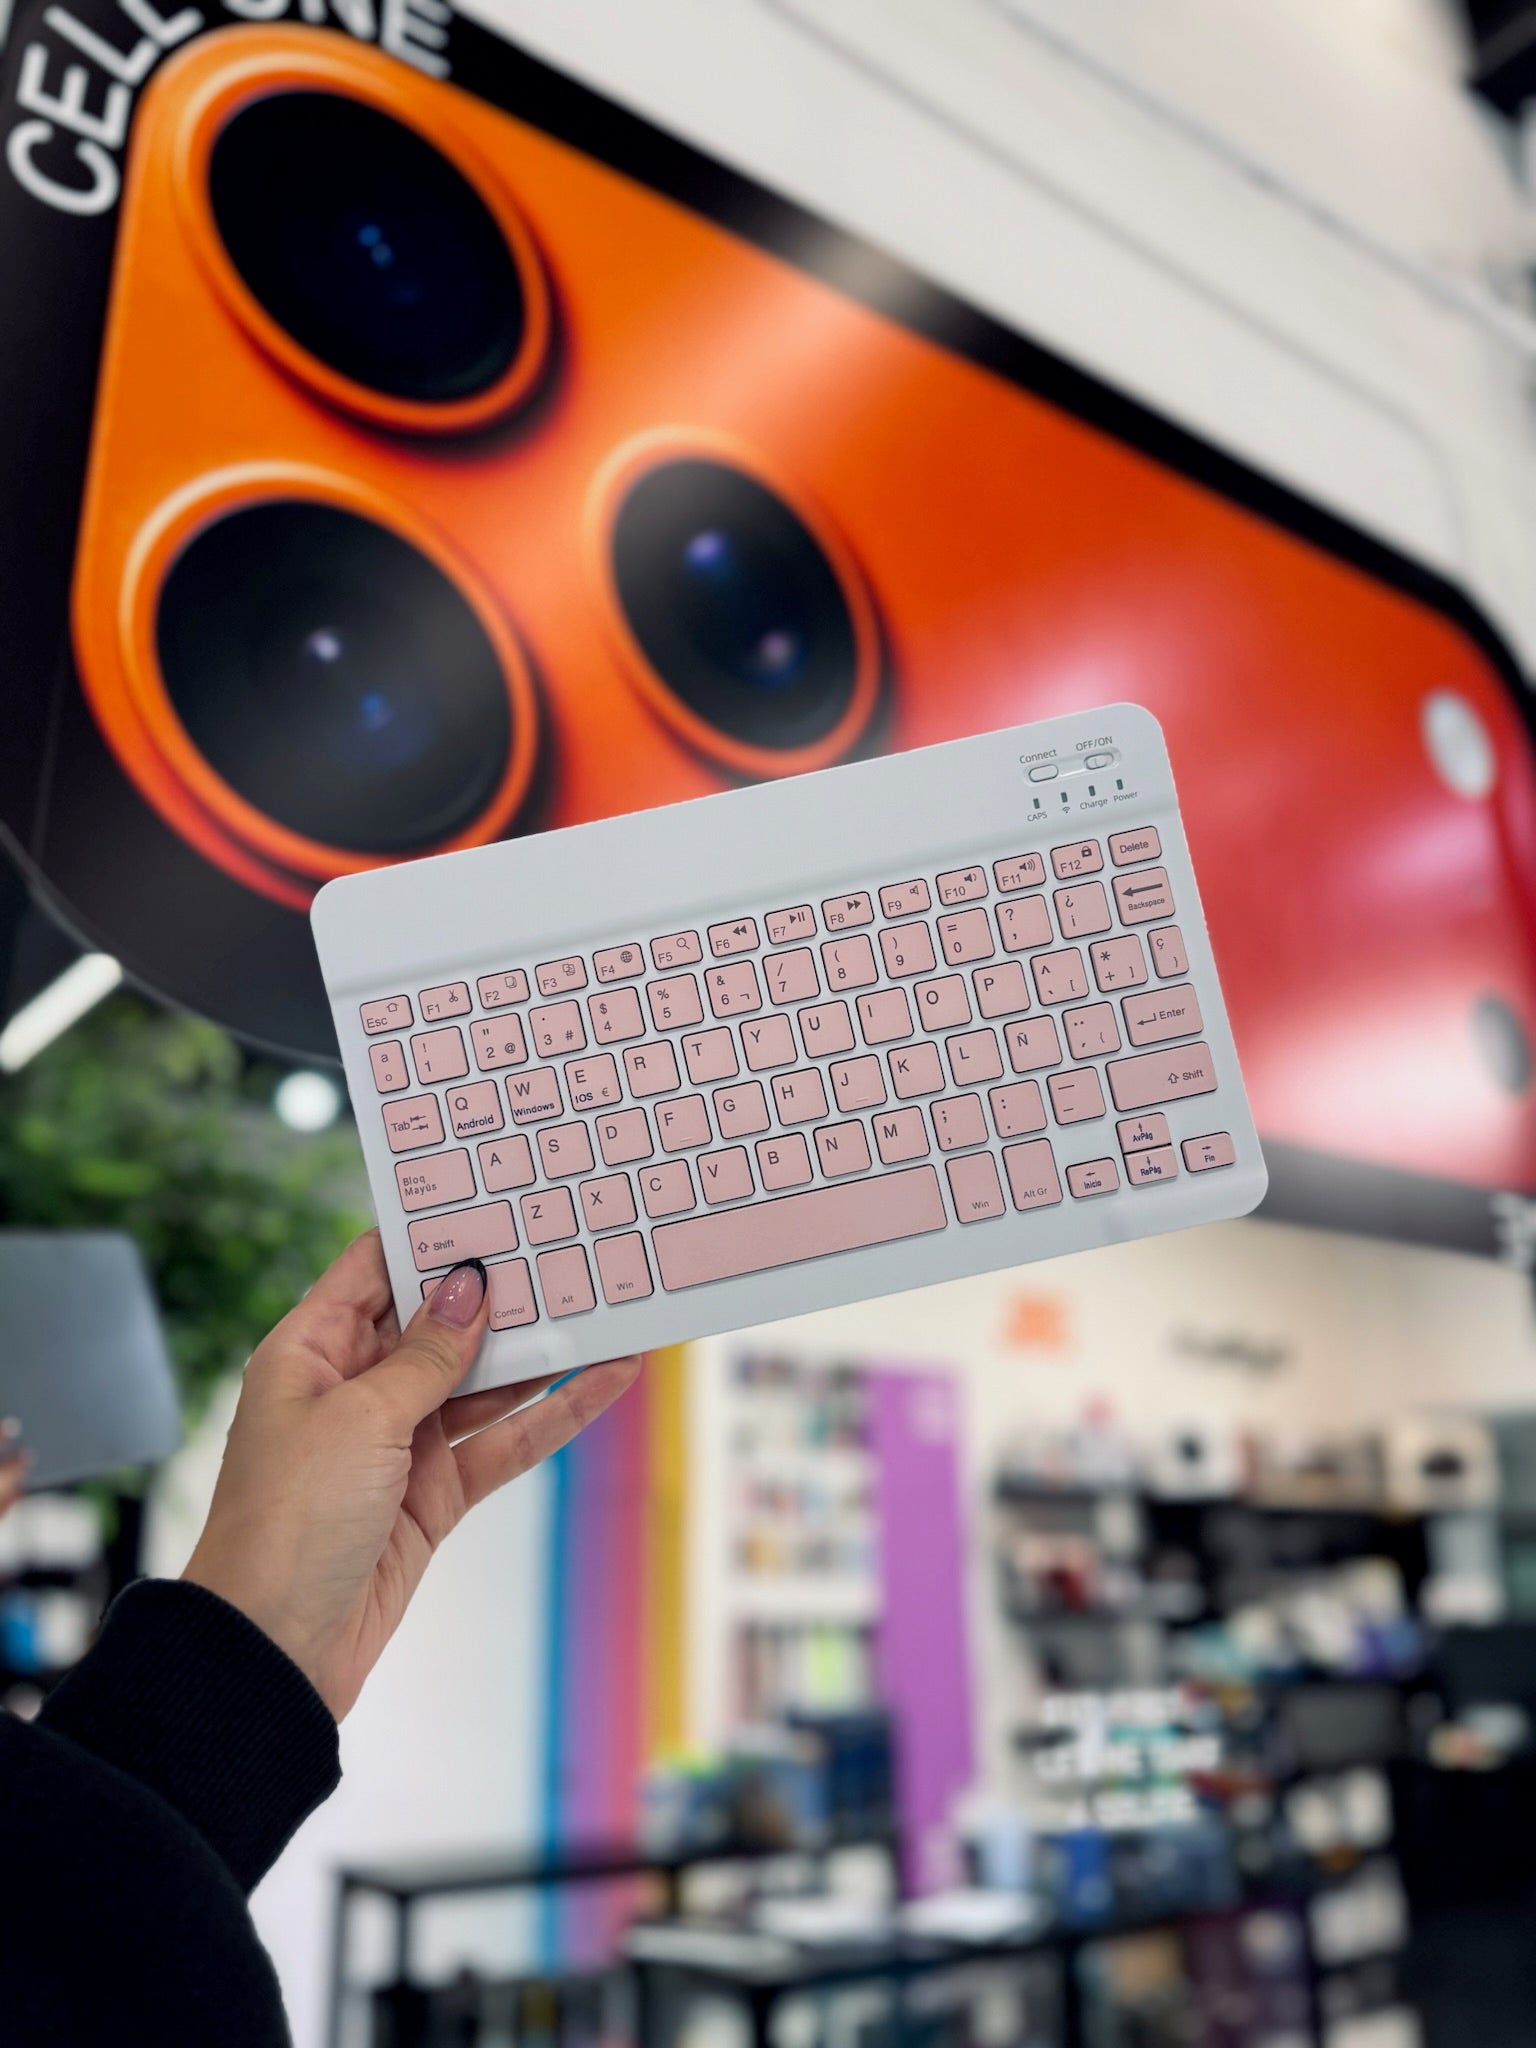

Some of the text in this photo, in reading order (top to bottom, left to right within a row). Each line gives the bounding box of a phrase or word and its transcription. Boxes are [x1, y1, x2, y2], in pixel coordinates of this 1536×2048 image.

[1076, 736, 1112, 751] OFF/ON
[1019, 749, 1057, 764] Connect
[1114, 791, 1138, 802] Power
[1080, 798, 1108, 810] Charge
[1027, 812, 1048, 822] CAPS
[1120, 840, 1149, 854] Delete
[1060, 860, 1082, 872] F12
[1002, 874, 1021, 886] F11
[944, 886, 965, 899] F10
[887, 900, 902, 912] F9
[1128, 898, 1165, 911] Backspace
[830, 913, 845, 925] F8
[1005, 908, 1014, 921] ?
[773, 926, 786, 937] F7
[715, 939, 730, 950] F6
[658, 952, 672, 963] F5
[895, 954, 904, 966] 9
[601, 965, 615, 976] F4
[837, 968, 846, 979] 8
[542, 978, 557, 989] F3
[716, 975, 725, 986] &
[778, 981, 787, 992] 7
[984, 977, 994, 992] P
[485, 991, 500, 1002] F2
[657, 988, 669, 1000] %
[721, 994, 730, 1005] 6
[926, 991, 939, 1005] O
[427, 1004, 441, 1015] F1
[600, 1003, 607, 1015] $
[663, 1007, 671, 1018] 5
[868, 1004, 873, 1018] I
[1159, 1008, 1186, 1020] Enter
[367, 1016, 388, 1029] Esc
[604, 1021, 612, 1032] 4
[808, 1016, 820, 1031] U
[544, 1030, 574, 1045] 3 #
[750, 1029, 761, 1043] Y
[1017, 1032, 1028, 1047] Ñ
[487, 1042, 516, 1058] 2 @
[692, 1043, 702, 1056] T
[959, 1047, 969, 1060] L
[424, 1060, 432, 1072] 1
[634, 1056, 646, 1070] R
[897, 1059, 910, 1073] K
[575, 1069, 587, 1083] E
[840, 1073, 849, 1086] J
[1182, 1069, 1204, 1081] Shift
[514, 1082, 530, 1097] W
[781, 1085, 794, 1100] H
[455, 1097, 469, 1111] Q
[514, 1102, 555, 1117] Windows
[723, 1099, 736, 1112] G
[456, 1115, 494, 1132] Android
[664, 1112, 674, 1126] F
[391, 1121, 410, 1133] Tab
[606, 1125, 617, 1140] D
[883, 1123, 898, 1139] M
[548, 1139, 560, 1153] S
[826, 1137, 838, 1151] N
[490, 1153, 502, 1166] A
[767, 1151, 779, 1165] B
[1204, 1154, 1215, 1162] Fin
[707, 1164, 718, 1178] V
[402, 1175, 426, 1187] Bloq
[649, 1177, 662, 1192] C
[590, 1191, 603, 1206] X
[1024, 1186, 1048, 1198] Alt Gr
[972, 1200, 990, 1210] Win
[530, 1205, 543, 1219] Z
[433, 1239, 454, 1250] Shift
[616, 1281, 634, 1291] Win
[561, 1295, 574, 1304] Alt
[495, 1306, 525, 1319] Control
